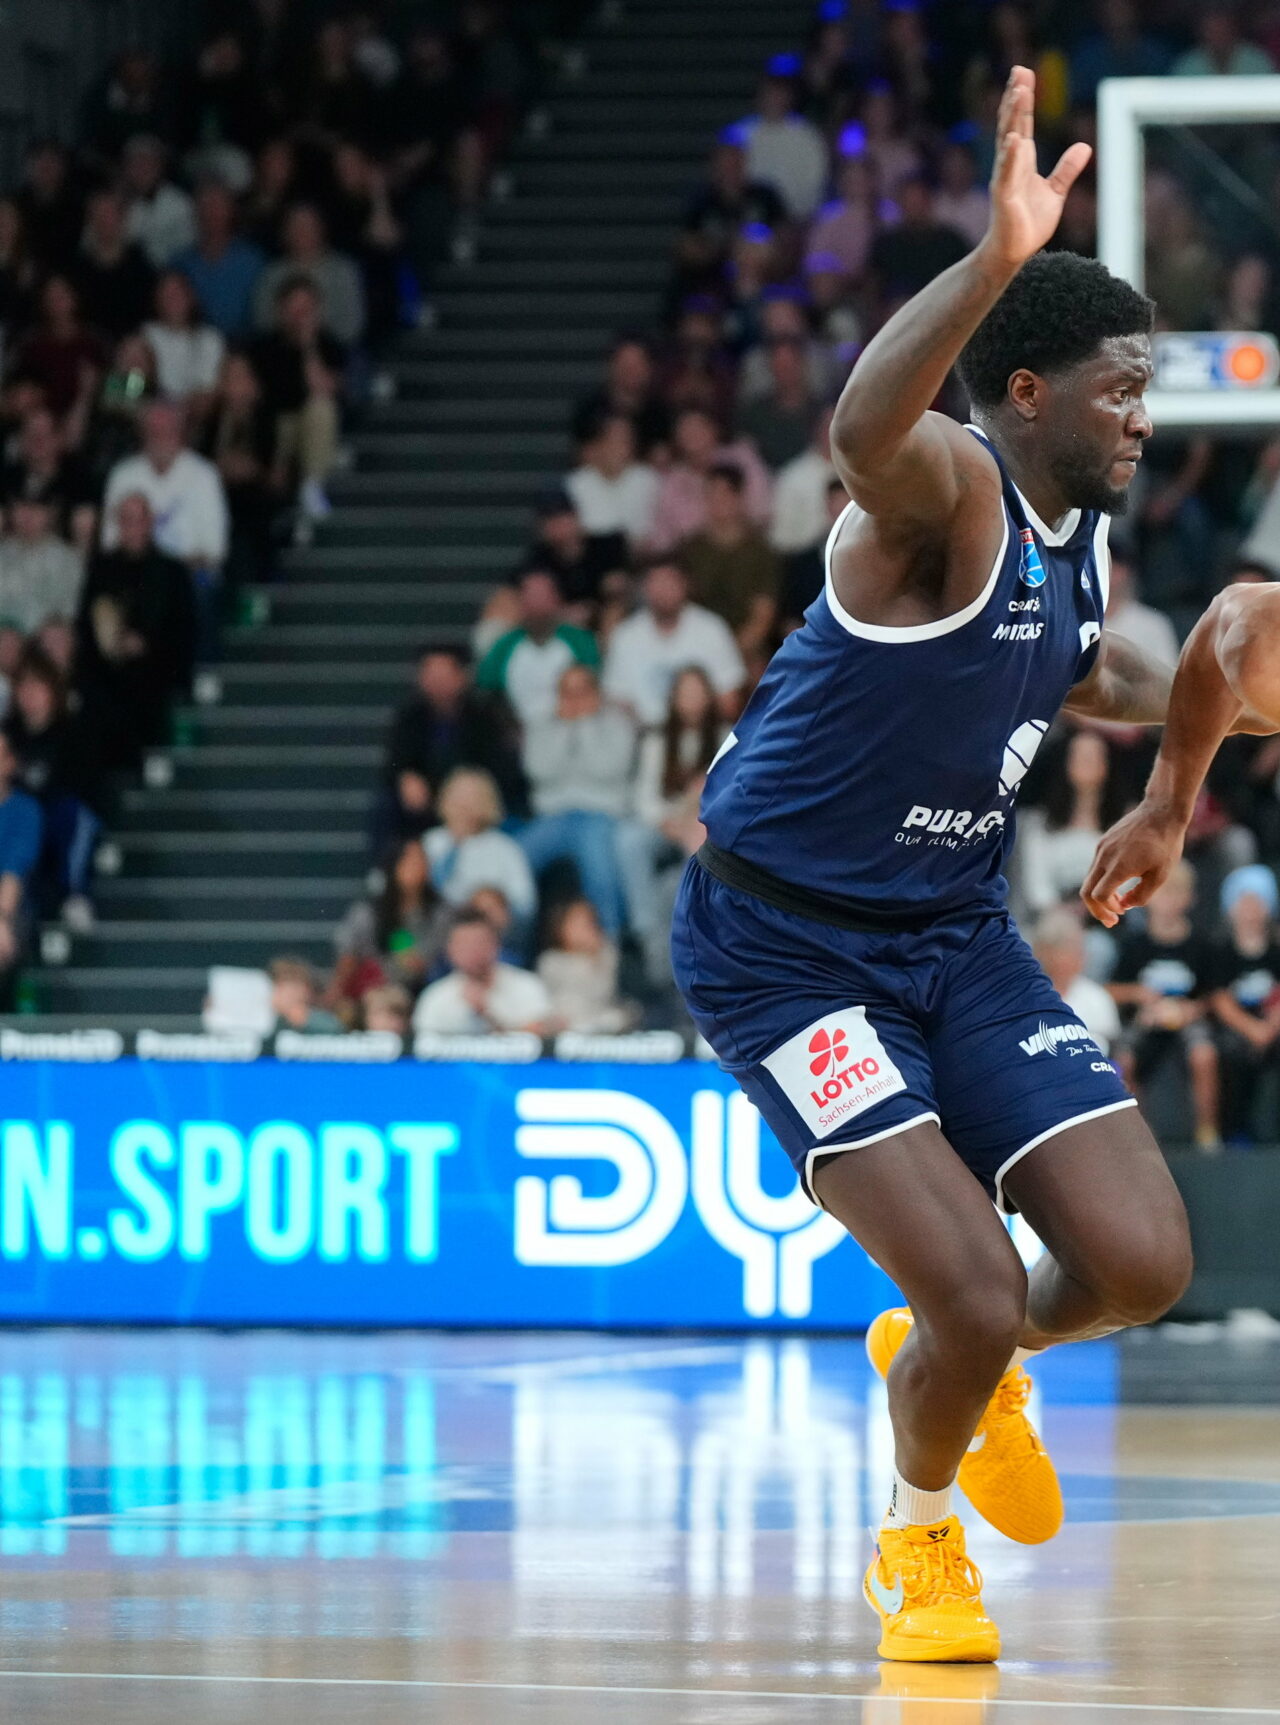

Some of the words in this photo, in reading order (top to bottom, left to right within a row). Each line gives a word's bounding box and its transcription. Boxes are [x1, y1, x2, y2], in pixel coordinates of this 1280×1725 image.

[810, 1057, 879, 1108] LOTTO
[1090, 1062, 1116, 1074] CRA
[818, 1075, 897, 1128] Sachsen-Anhalt
